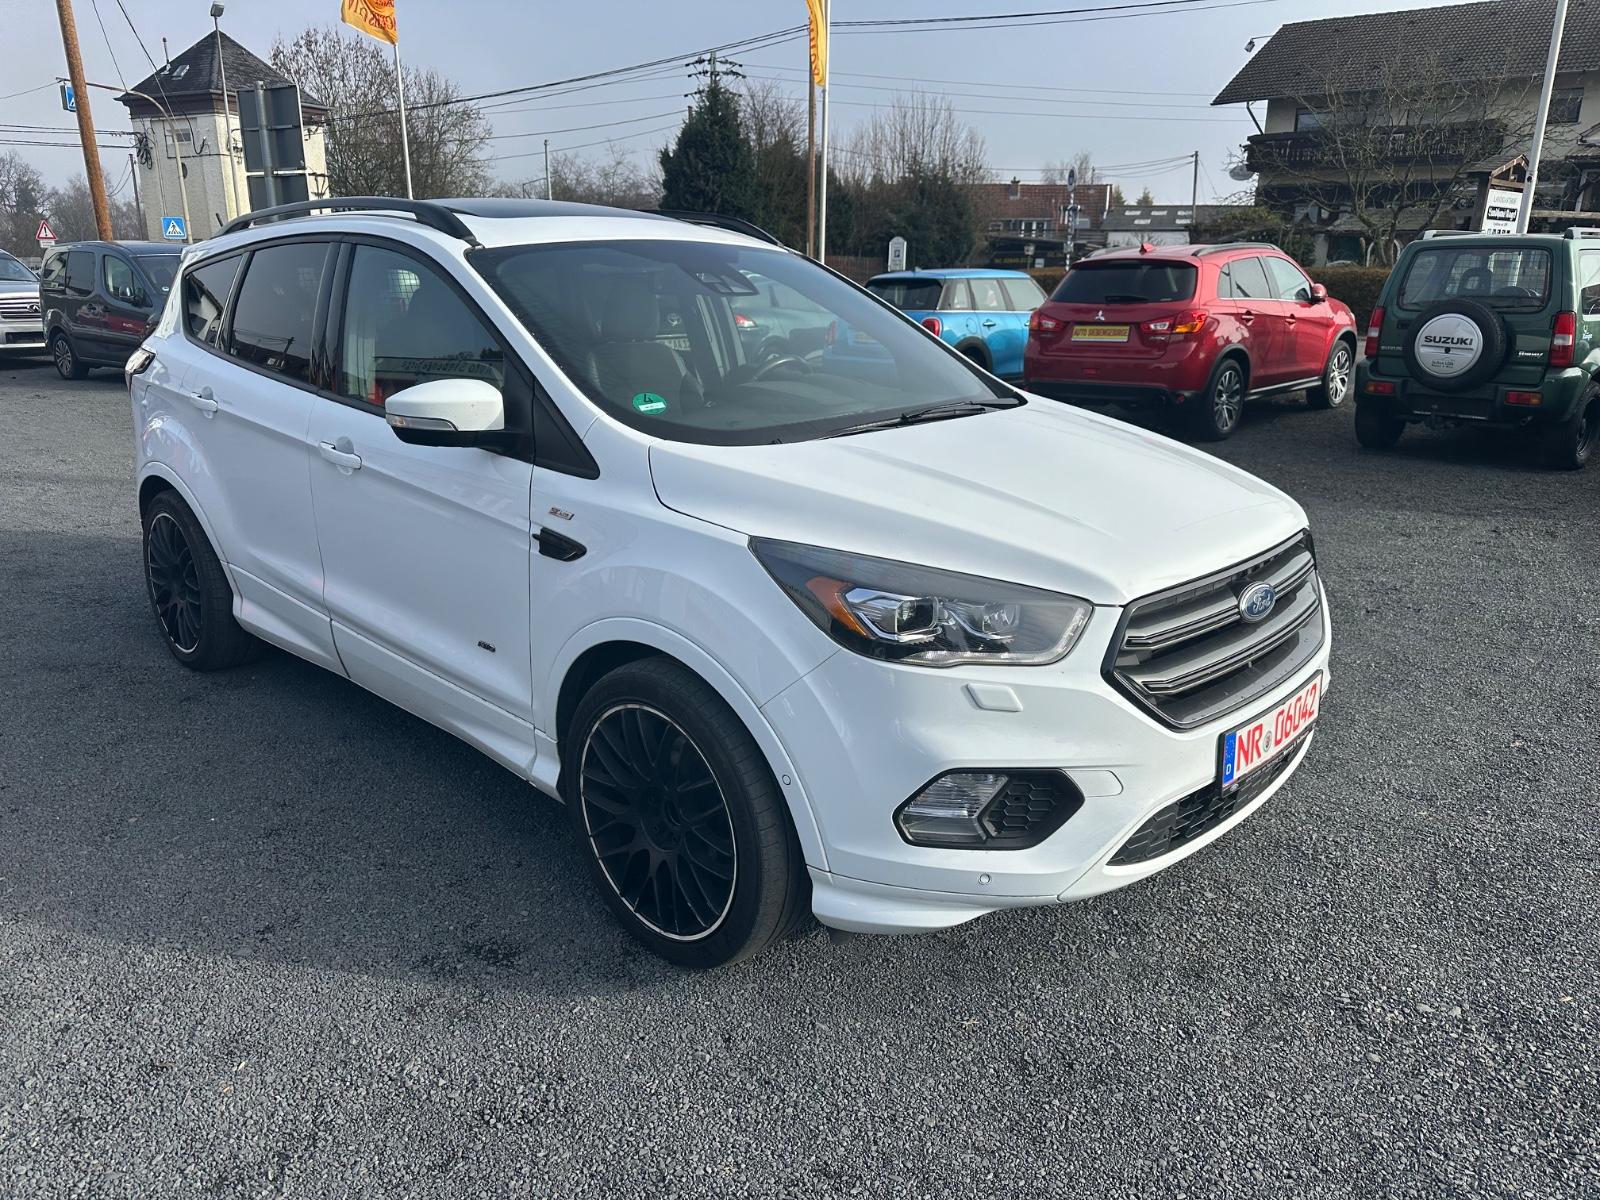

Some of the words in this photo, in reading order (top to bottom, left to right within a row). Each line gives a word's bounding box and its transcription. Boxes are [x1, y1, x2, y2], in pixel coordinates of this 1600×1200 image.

[1424, 335, 1474, 346] SUZUKI
[1252, 592, 1271, 613] Ford
[1225, 763, 1232, 776] D
[1236, 723, 1264, 773] NR
[1274, 683, 1317, 747] 06042
